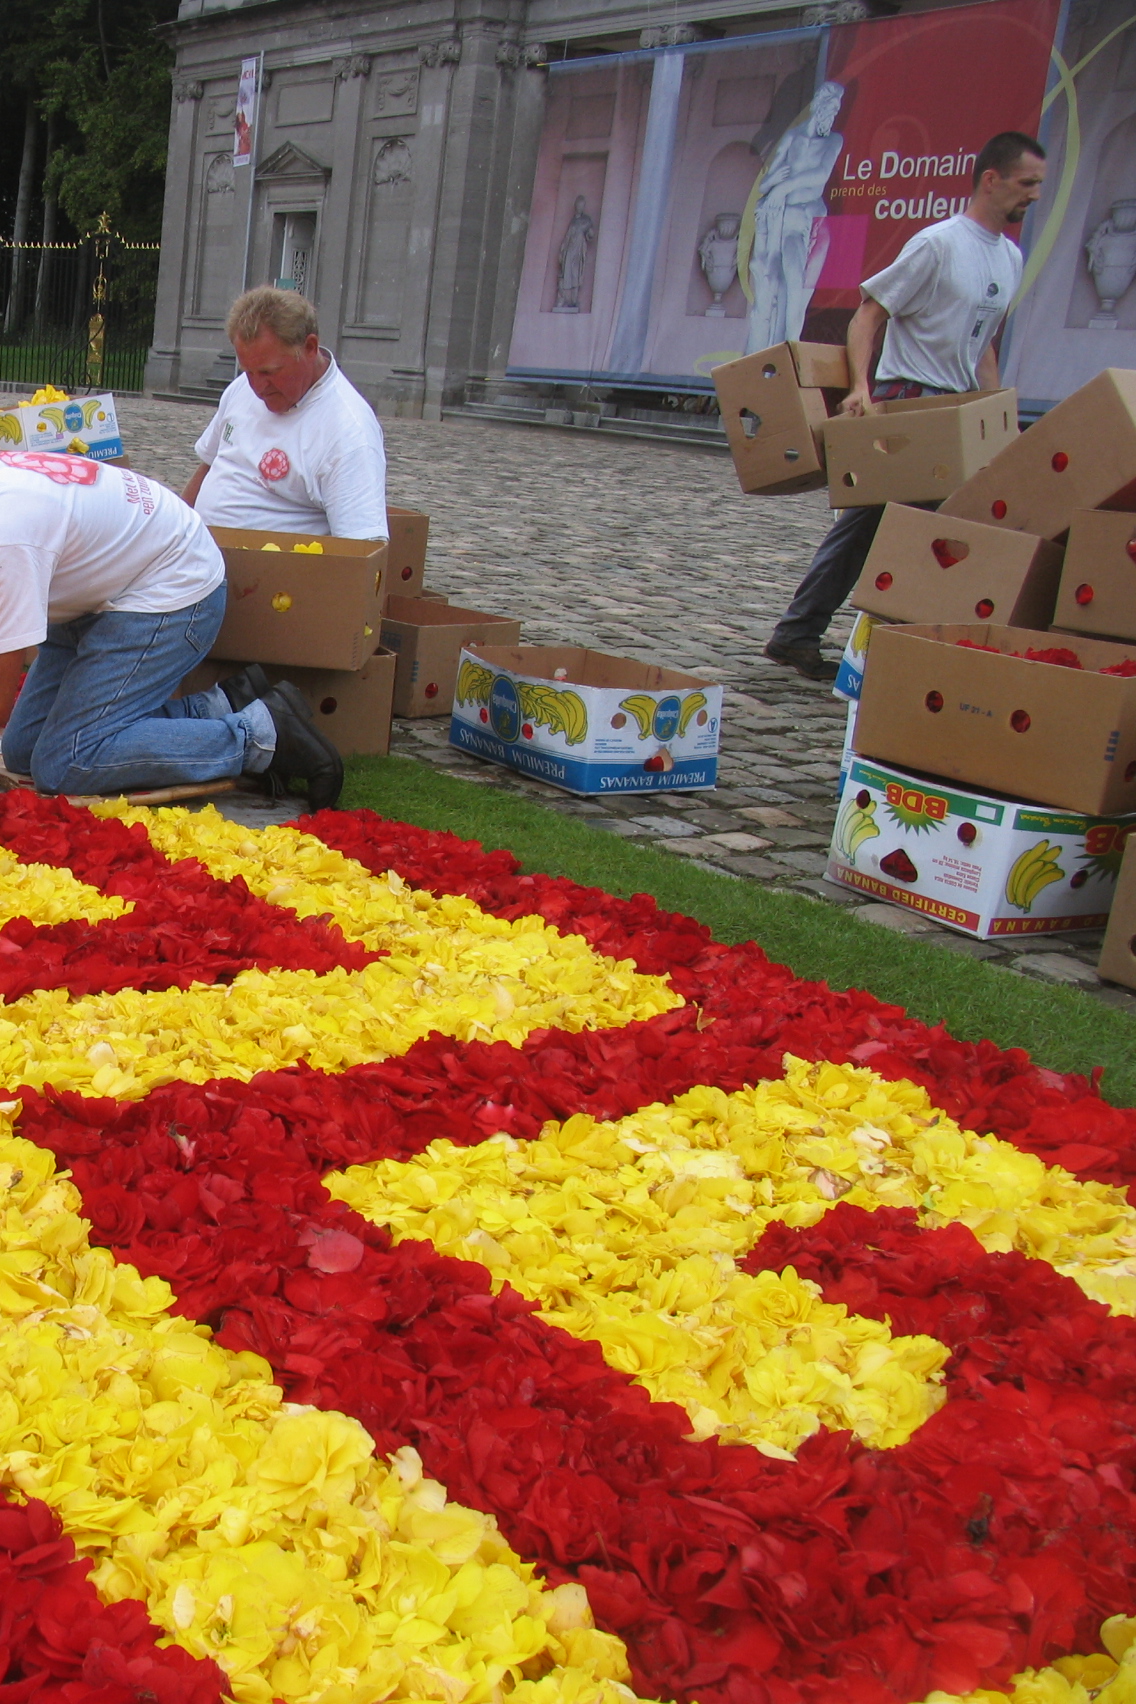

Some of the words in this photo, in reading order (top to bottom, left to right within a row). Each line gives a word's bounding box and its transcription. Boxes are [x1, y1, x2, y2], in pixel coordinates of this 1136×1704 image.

[843, 154, 872, 180] Le
[880, 147, 977, 179] Domain
[830, 184, 864, 199] prend
[867, 184, 886, 196] des
[460, 728, 504, 757] BANANAS
[511, 749, 565, 779] PREMIUM
[658, 771, 706, 785] PREMIUM
[600, 775, 654, 789] BANANAS
[886, 782, 948, 820] BDB
[837, 867, 887, 896] BANANA
[891, 889, 967, 924] CERTIFIED
[994, 919, 1072, 932] BANANA
